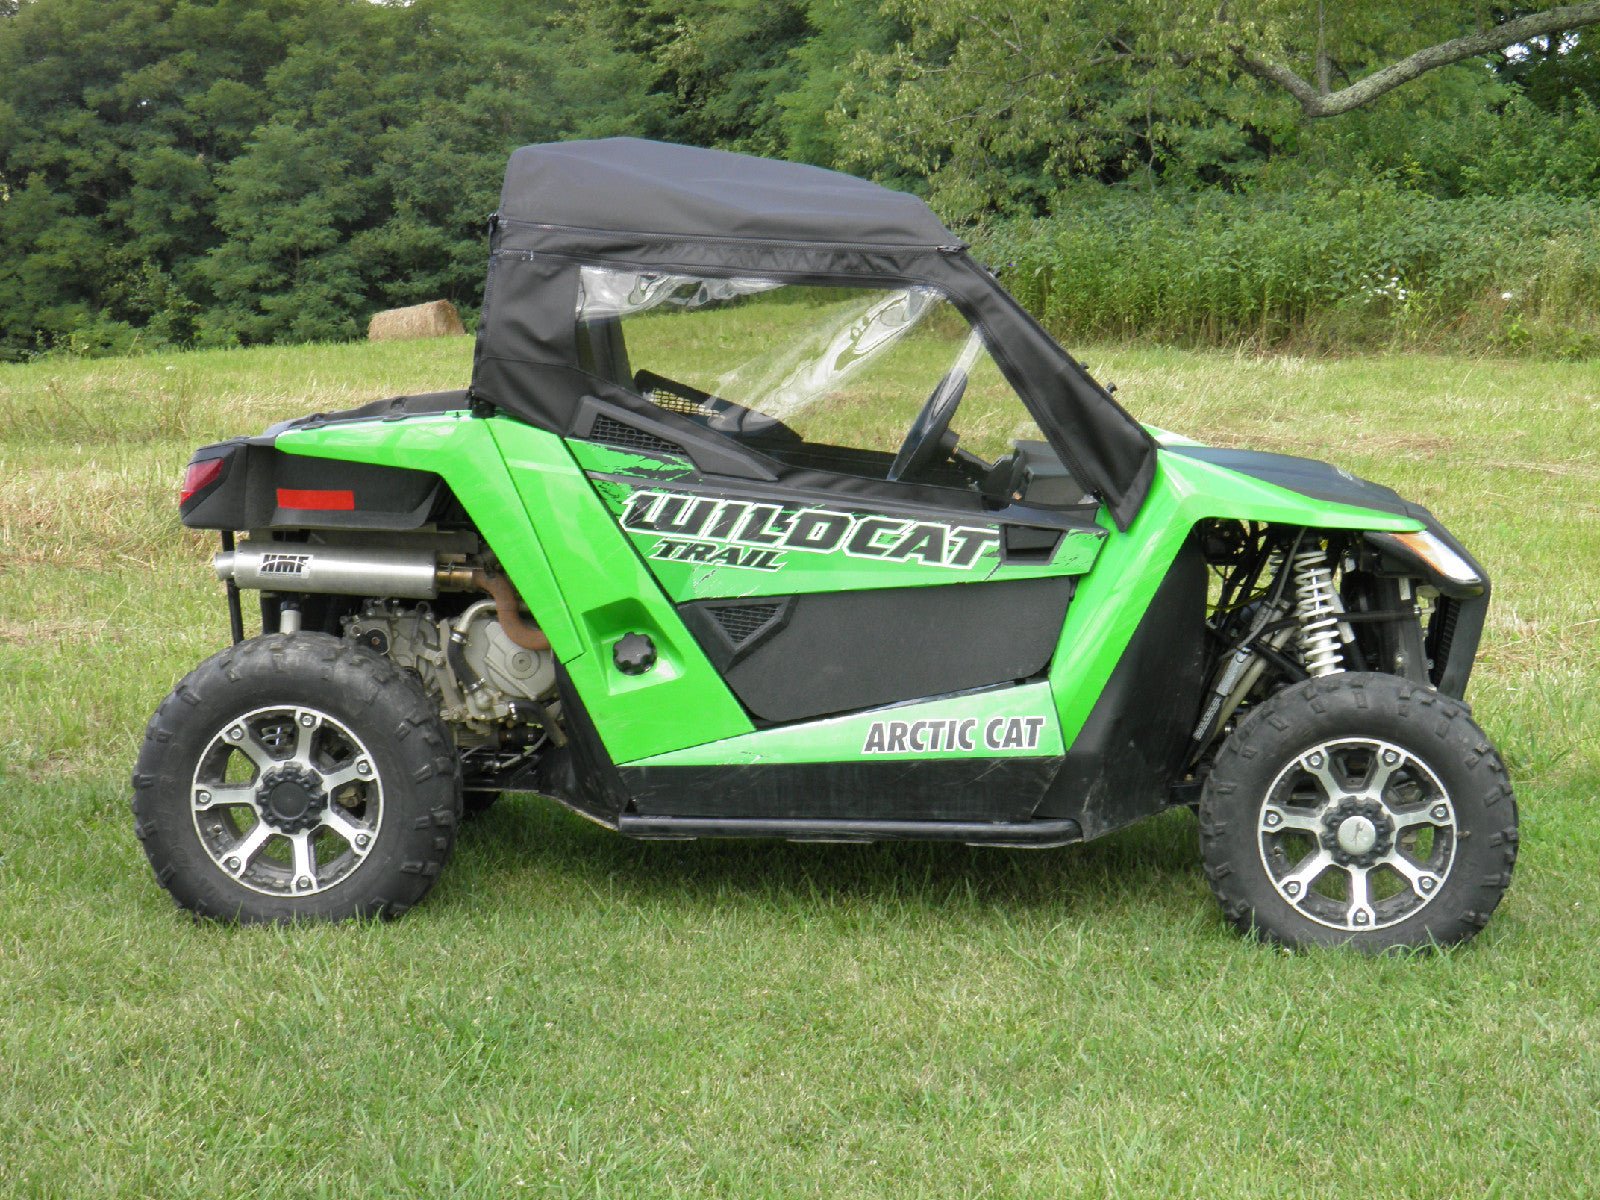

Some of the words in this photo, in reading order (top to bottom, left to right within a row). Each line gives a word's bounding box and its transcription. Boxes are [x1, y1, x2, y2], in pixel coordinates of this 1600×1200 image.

[618, 490, 1000, 570] WILDCAT
[649, 537, 788, 572] TRAIL
[862, 719, 978, 753] ARCTIC
[985, 716, 1046, 750] CAT
